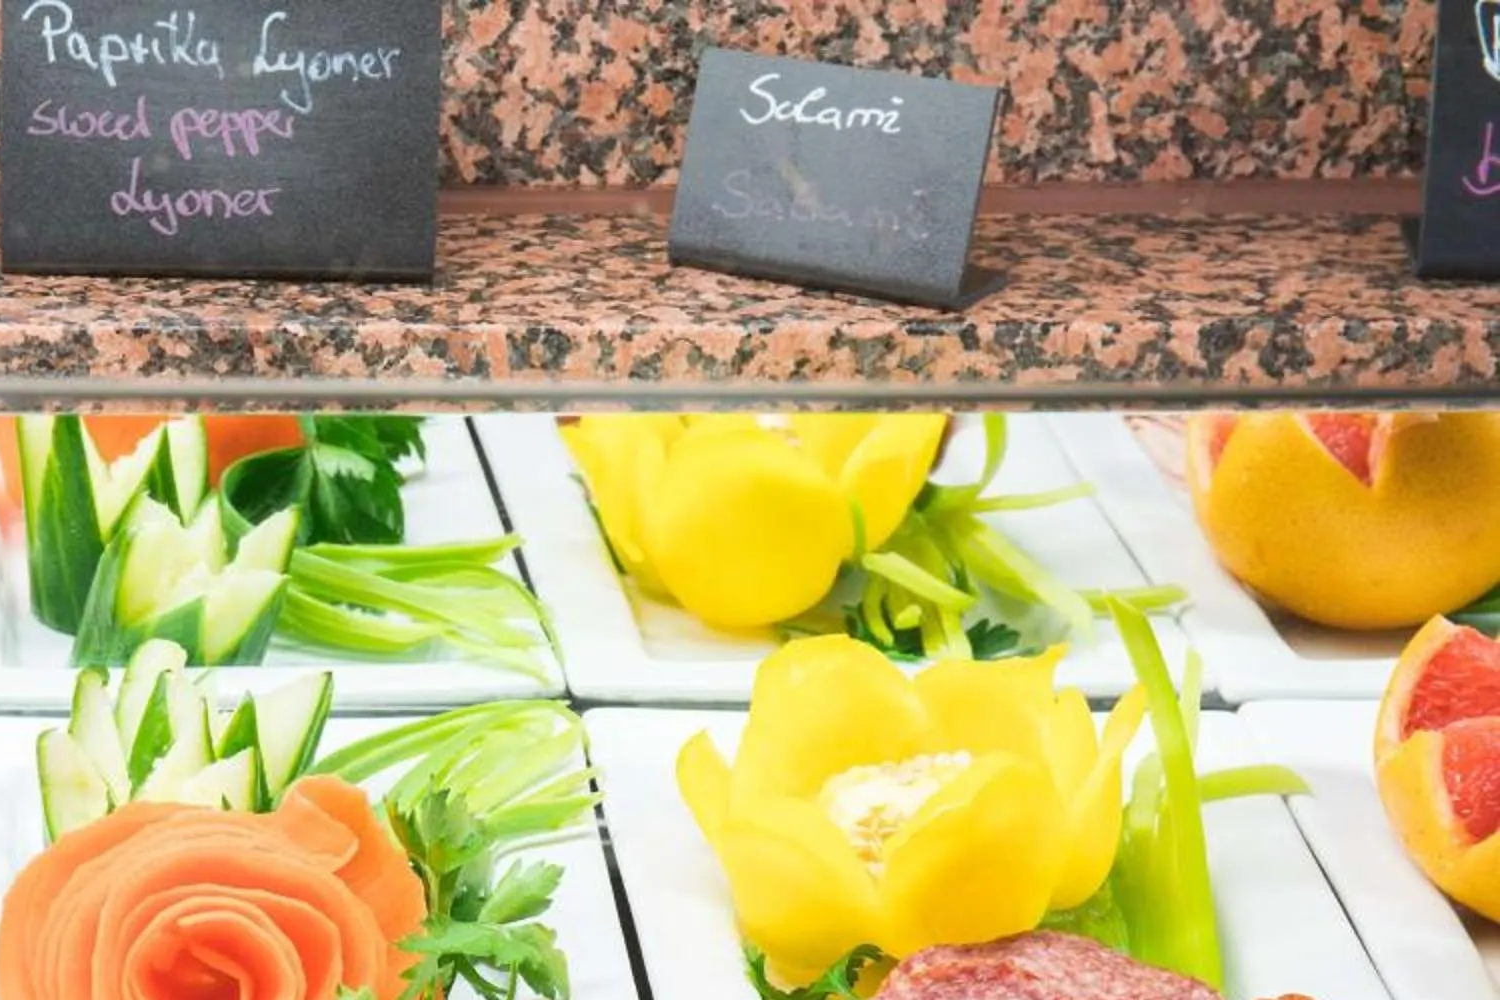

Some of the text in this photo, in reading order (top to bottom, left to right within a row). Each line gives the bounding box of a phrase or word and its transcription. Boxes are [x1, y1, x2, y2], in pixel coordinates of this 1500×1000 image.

[22, 0, 225, 87] Paprika
[169, 107, 295, 160] pepper
[739, 73, 904, 134] Salami
